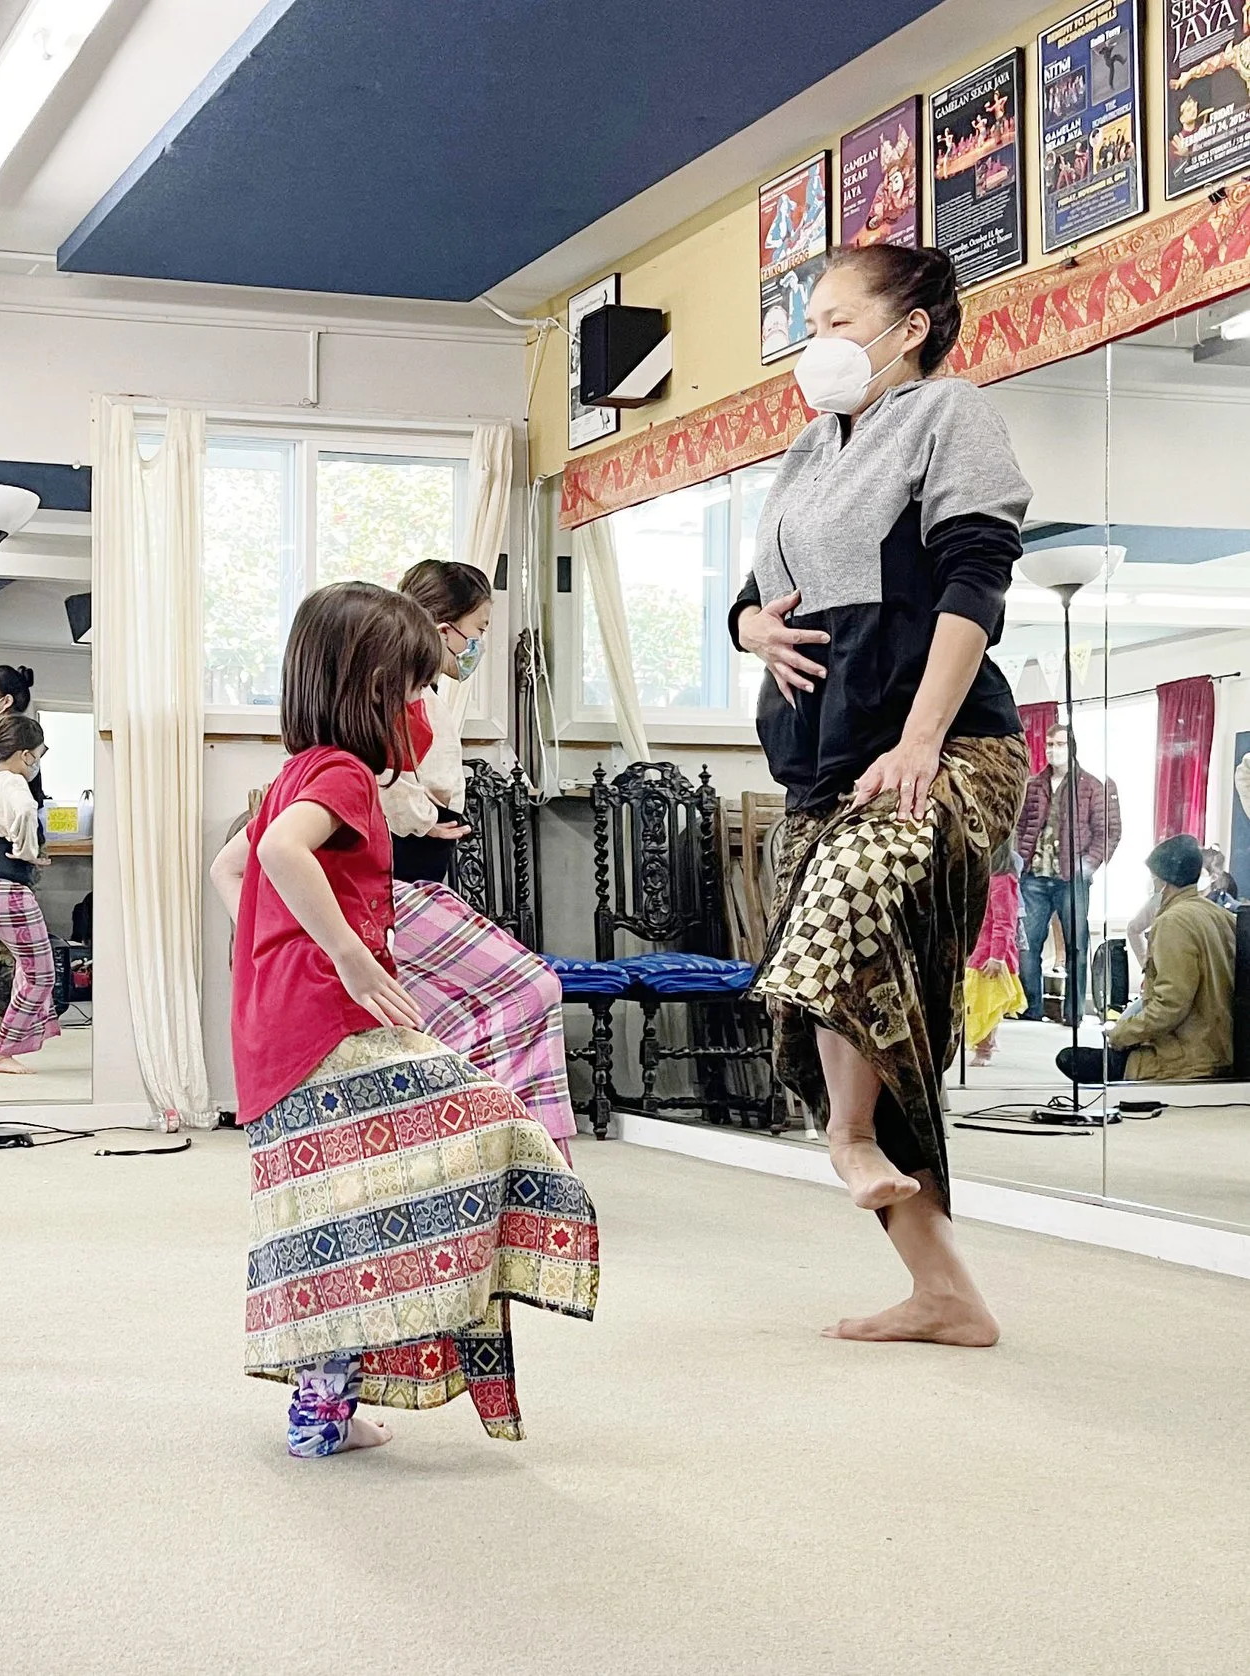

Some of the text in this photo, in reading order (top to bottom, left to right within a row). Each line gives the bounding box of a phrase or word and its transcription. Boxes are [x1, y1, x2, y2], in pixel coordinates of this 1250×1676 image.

[1172, 0, 1238, 63] JAYA
[935, 93, 970, 119] GAMELAN
[970, 81, 993, 101] SEKAR
[994, 71, 1010, 90] JAYA
[1210, 103, 1235, 124] FRIDAY
[1044, 117, 1082, 143] GAMELAN
[1045, 128, 1083, 152] SEKAR JAYA
[1181, 123, 1217, 148] FEBRUARY
[843, 147, 879, 175] GAMELAN
[843, 168, 868, 189] SEKAR
[843, 185, 862, 205] JAYA
